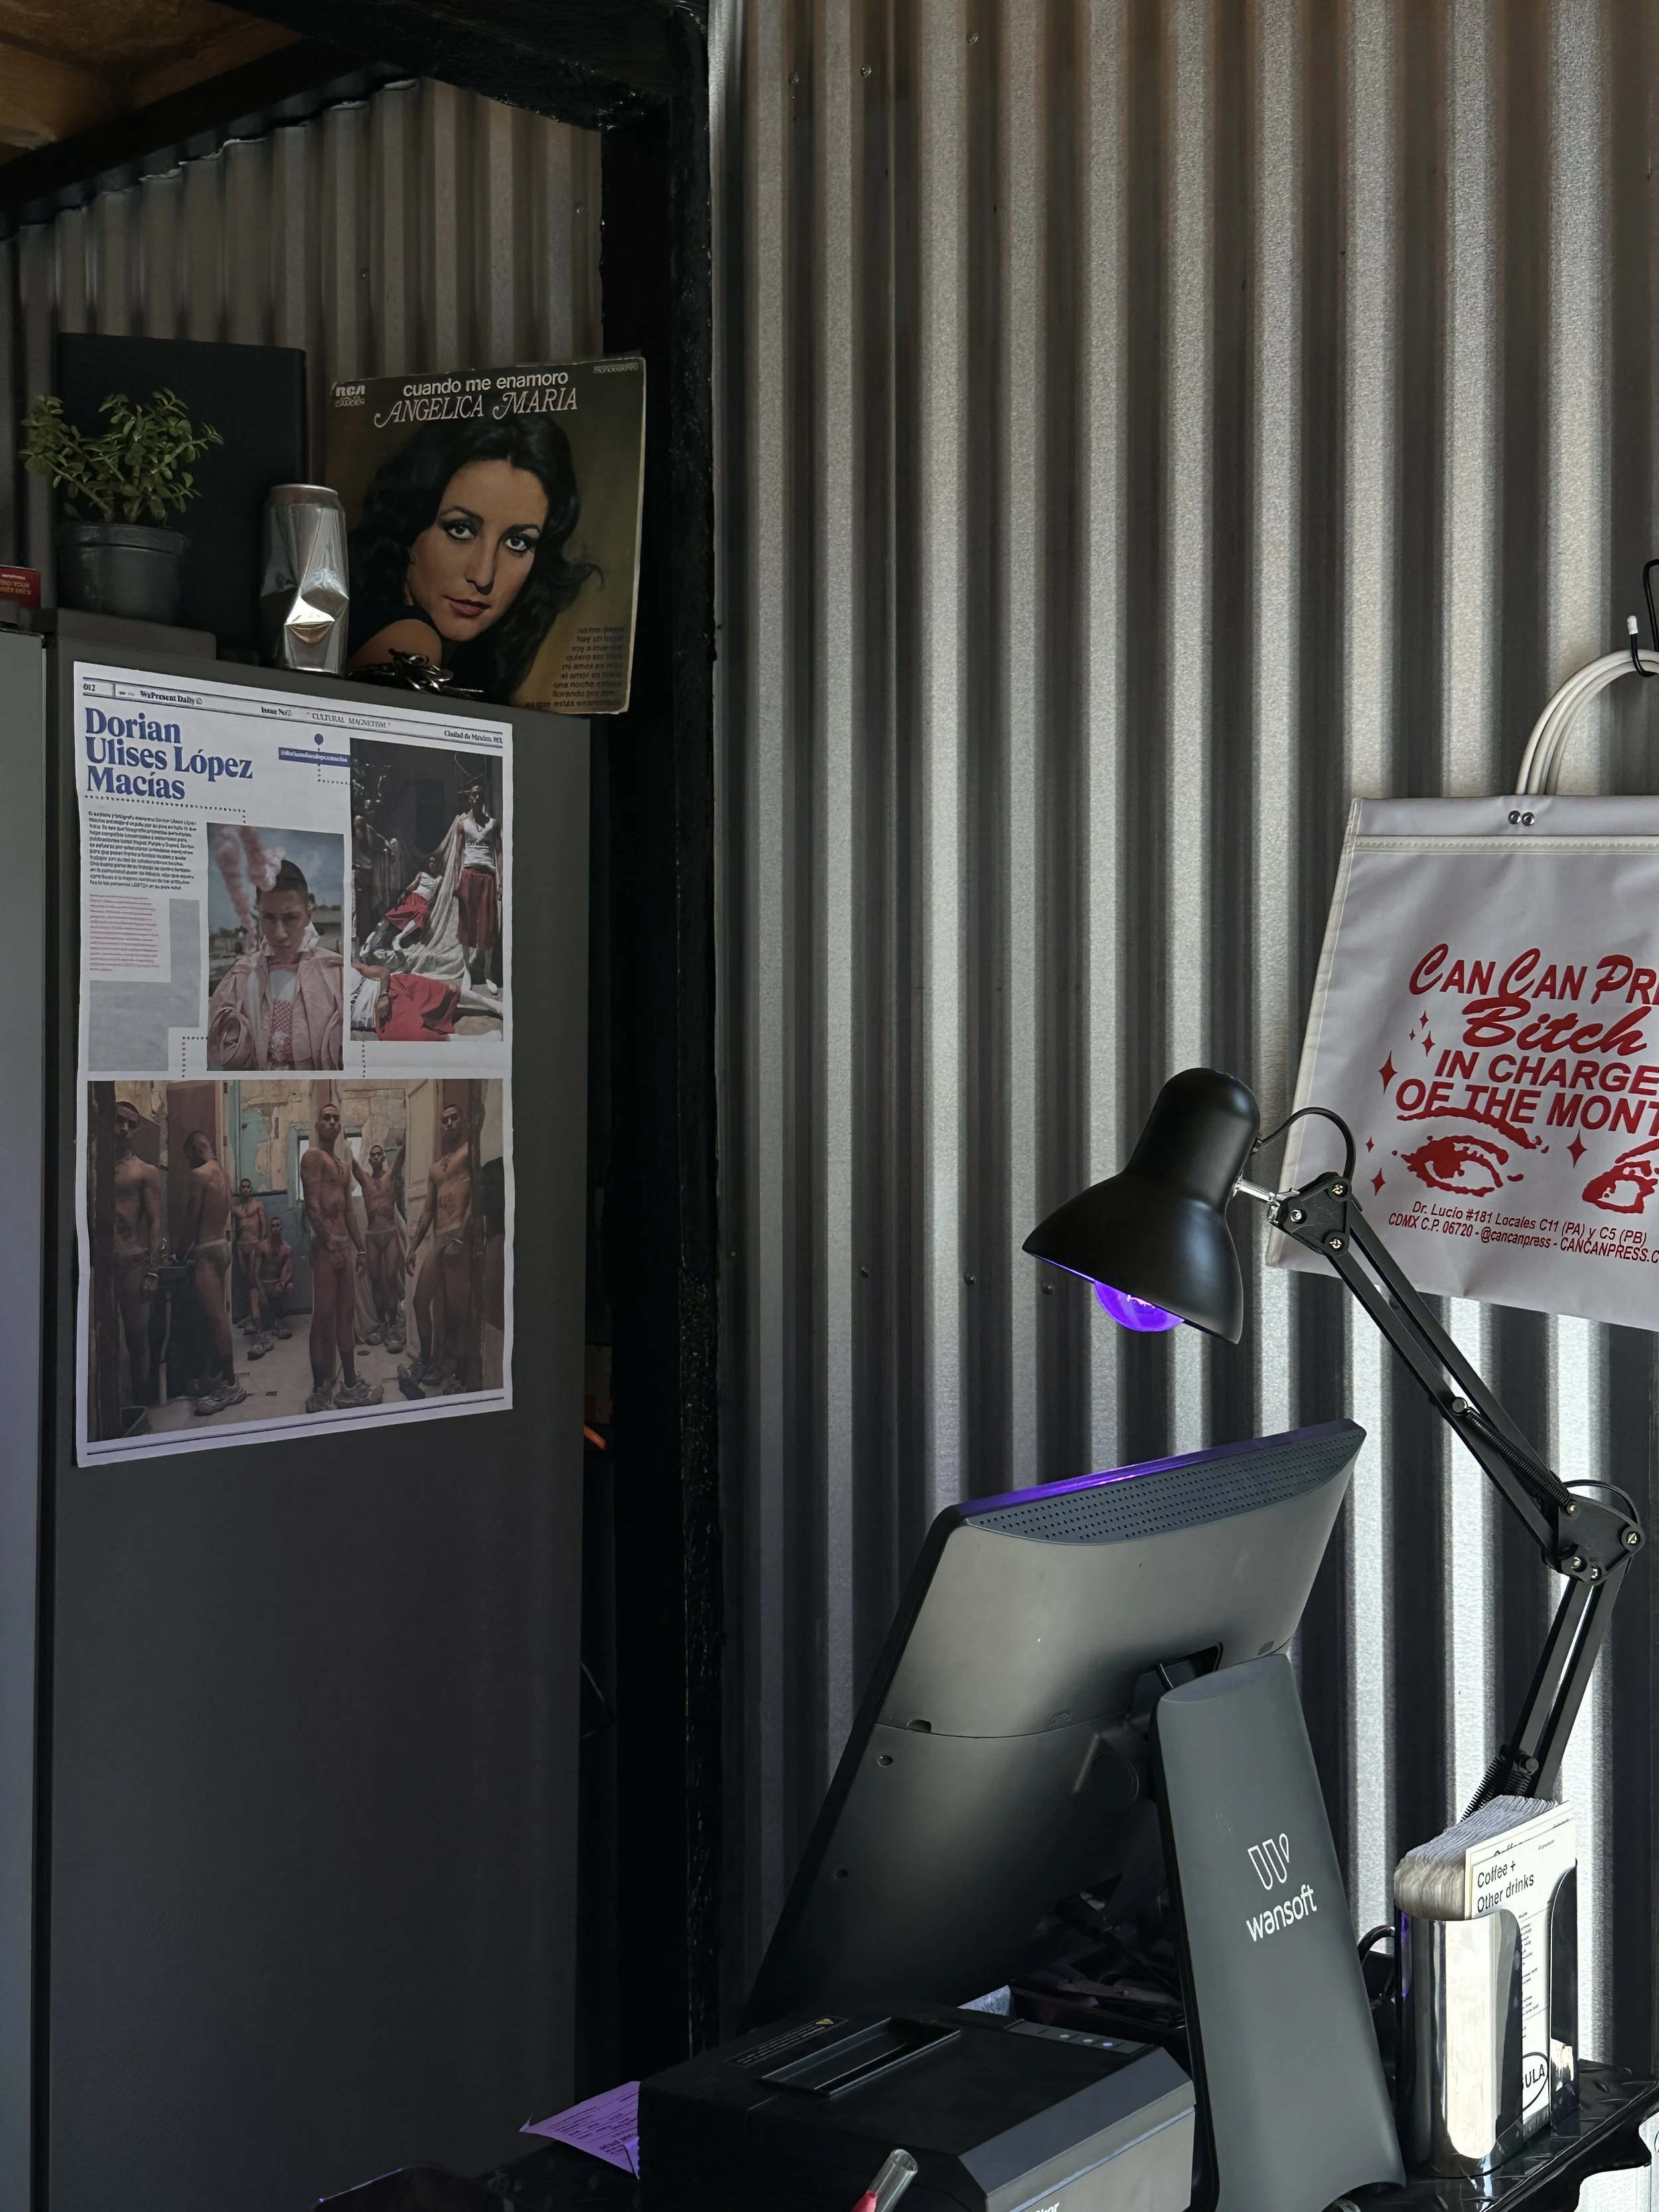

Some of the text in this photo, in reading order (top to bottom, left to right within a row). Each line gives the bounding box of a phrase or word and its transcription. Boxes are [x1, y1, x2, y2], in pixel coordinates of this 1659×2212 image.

[336, 385, 366, 397] RCA
[403, 370, 569, 397] cuando me enamoro
[374, 388, 578, 428] ANGELICA MARIA
[178, 695, 195, 705] Daily
[85, 707, 181, 744] Dorian
[85, 736, 253, 782] Ulises López
[87, 765, 186, 800] Macías
[1409, 943, 1659, 1005] CAN CAN PR
[1461, 996, 1652, 1057] Bitch
[1434, 1049, 1659, 1096] IN CHARGE
[1396, 1078, 1455, 1113] OF
[1465, 1084, 1542, 1124] THE
[1388, 1213, 1420, 1229] CDMX
[1421, 1217, 1439, 1232] C.P.
[1442, 1220, 1473, 1237] 06720
[1480, 1226, 1551, 1248] @cancanpress
[1412, 1201, 1647, 1248] Dr. Lucio #181 Locales C11 (PA) y C5 (PB)
[1477, 1863, 1508, 1889] Coffee
[1477, 1874, 1534, 1913] Other drinks
[1246, 1883, 1317, 1942] wansoft
[1522, 2063, 1545, 2089] ULA
